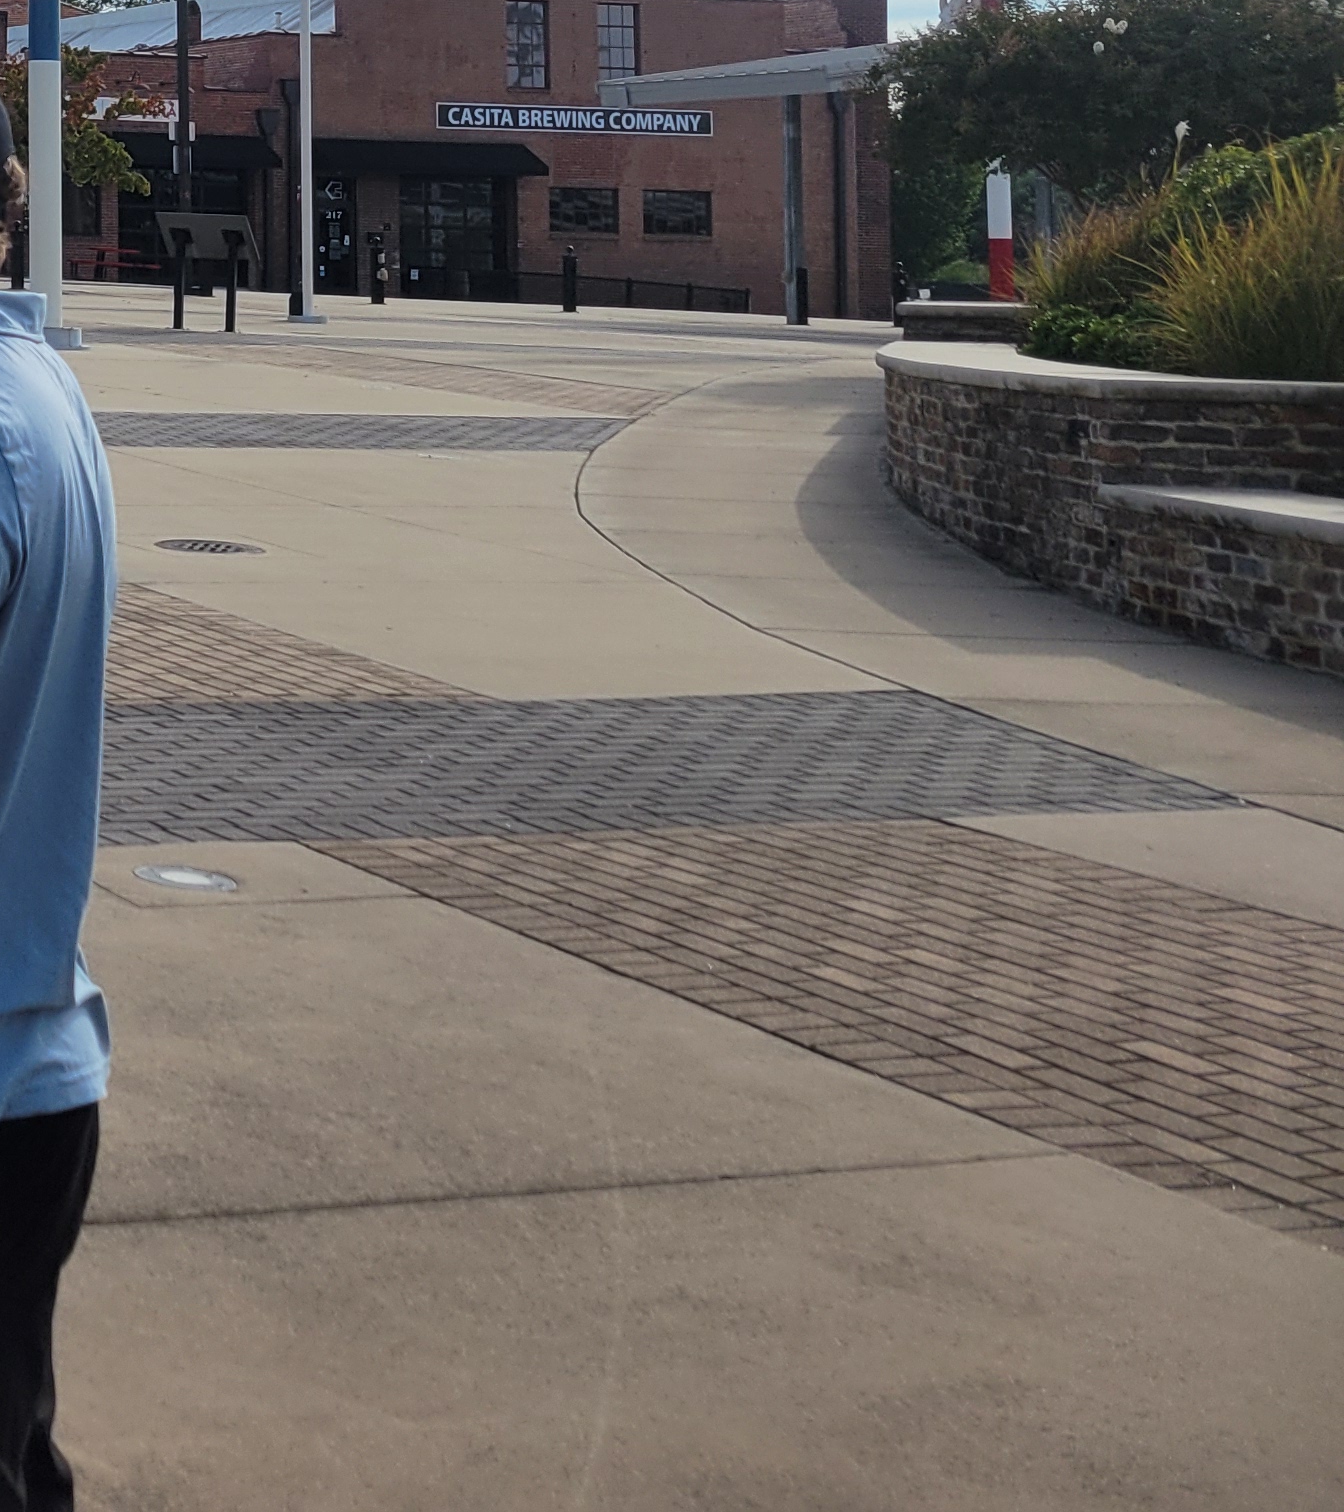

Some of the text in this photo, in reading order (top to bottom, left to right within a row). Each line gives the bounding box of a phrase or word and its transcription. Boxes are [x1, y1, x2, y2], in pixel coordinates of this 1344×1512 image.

[447, 107, 702, 133] CASITA BREWING COMPANY
[325, 210, 343, 220] 217
